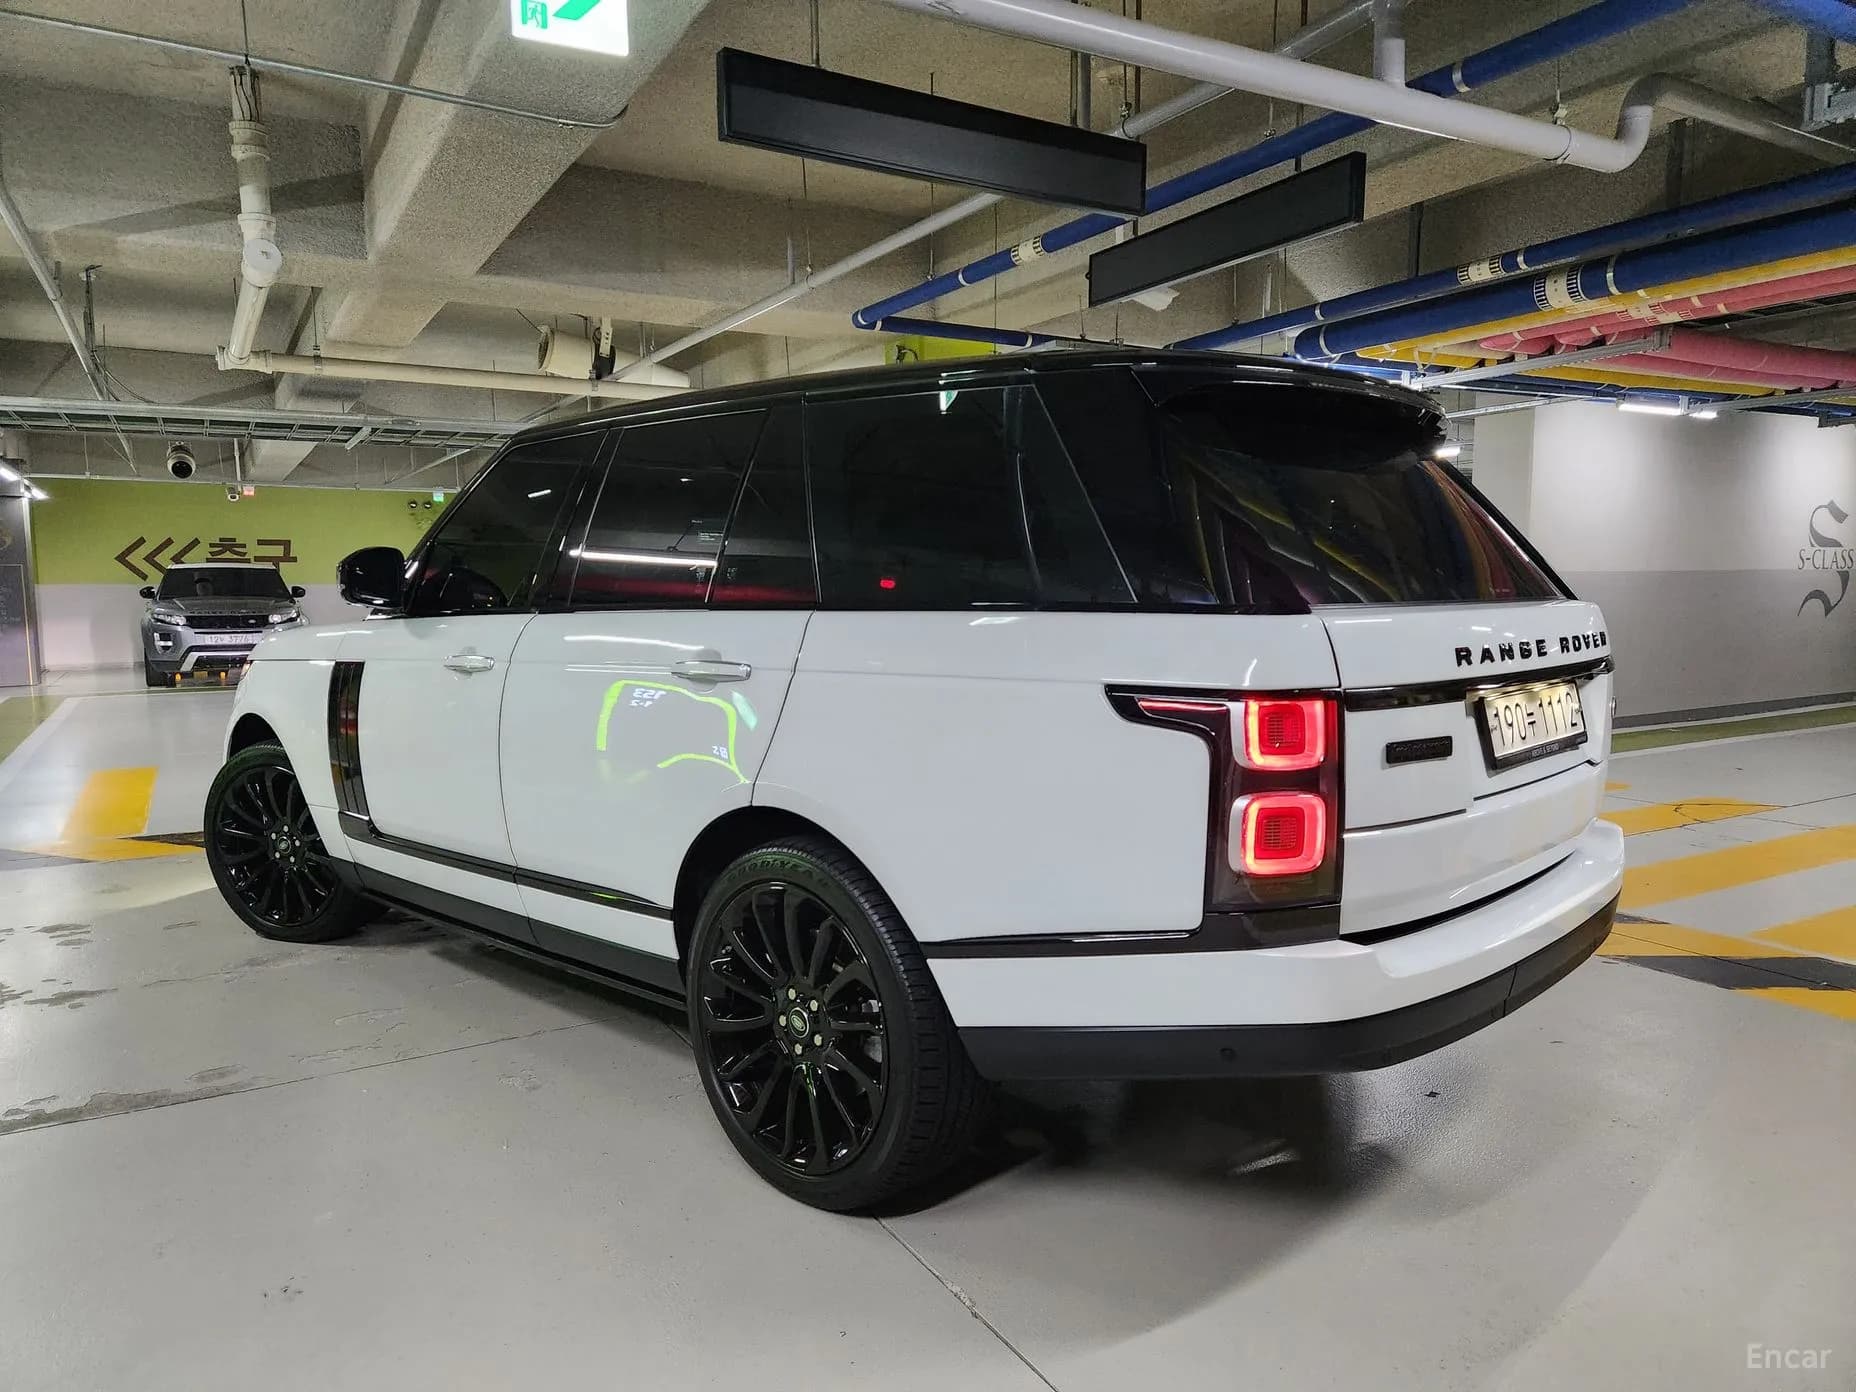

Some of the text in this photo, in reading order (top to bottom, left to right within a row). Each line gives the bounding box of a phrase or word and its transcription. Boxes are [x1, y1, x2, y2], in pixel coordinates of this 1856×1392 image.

[1798, 548, 1854, 570] S-CLASS
[1454, 631, 1607, 667] RANGE ROVER
